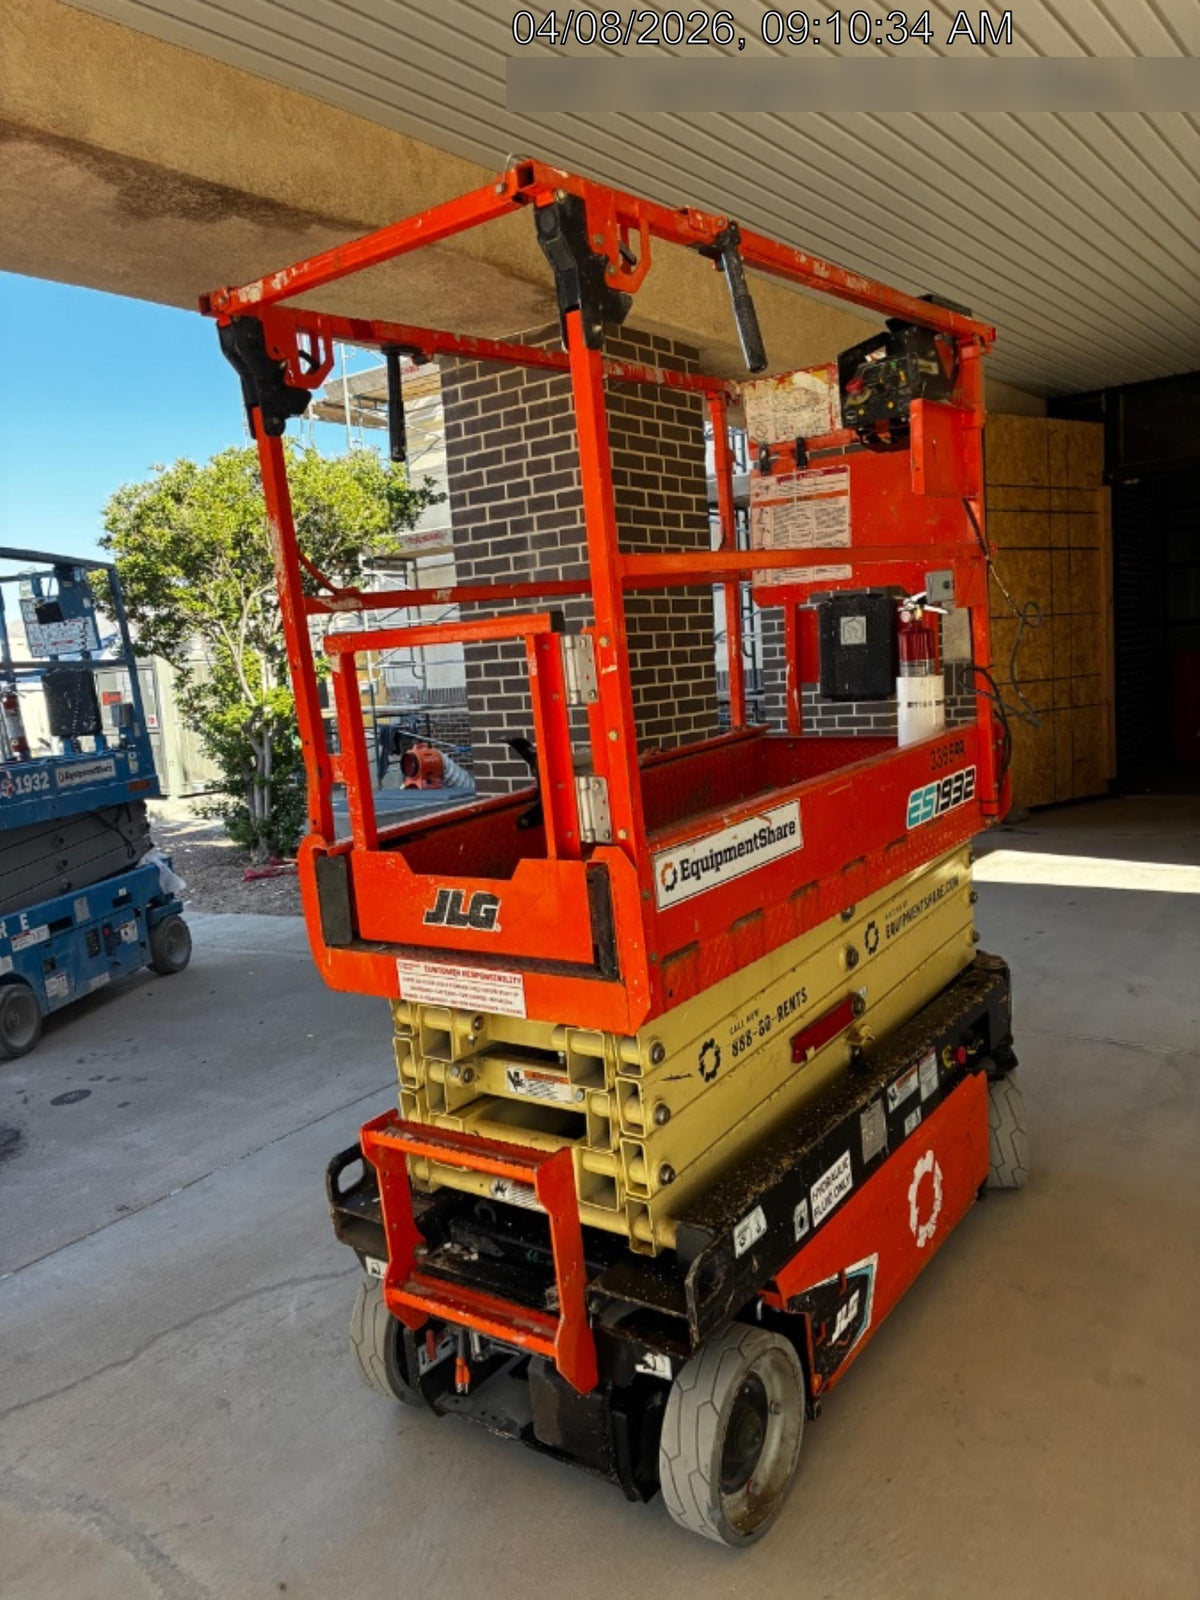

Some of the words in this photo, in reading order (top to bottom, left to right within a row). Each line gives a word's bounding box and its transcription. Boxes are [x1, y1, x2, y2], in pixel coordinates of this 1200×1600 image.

[15, 771, 51, 796] 1932
[679, 819, 798, 882] EquipmentShare
[422, 887, 501, 932] JLG
[812, 1156, 849, 1201] HYDRAULIC
[814, 1192, 833, 1218] FLUID
[834, 1173, 851, 1198] ONLY
